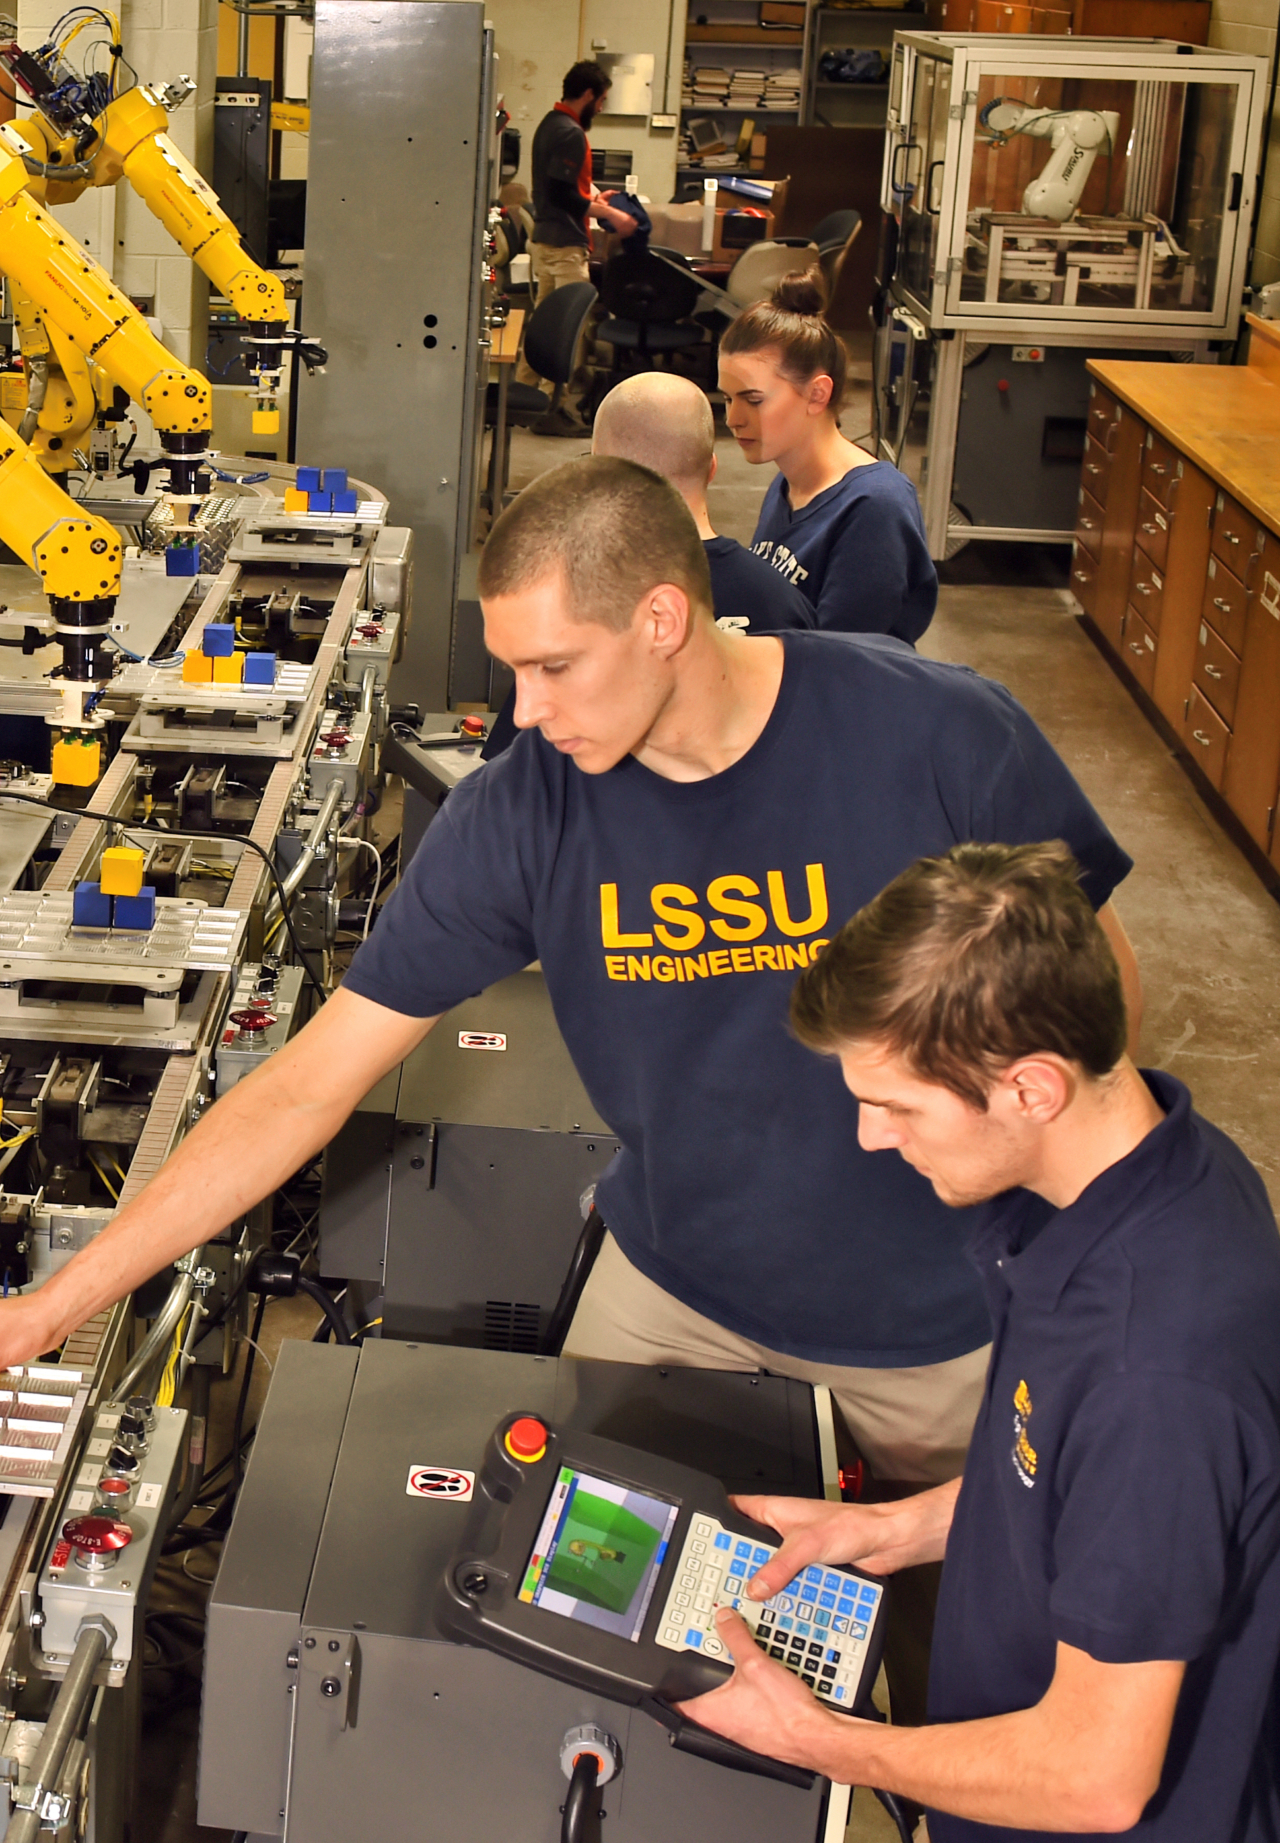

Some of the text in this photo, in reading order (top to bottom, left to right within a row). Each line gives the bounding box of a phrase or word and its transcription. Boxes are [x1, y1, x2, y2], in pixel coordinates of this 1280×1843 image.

[44, 269, 65, 291] FANUC
[599, 862, 829, 951] LSSU
[72, 1534, 102, 1547] E-STOP
[717, 1533, 727, 1548] SHIFT
[694, 1542, 703, 1551] F5
[689, 1559, 697, 1568] F4
[684, 1577, 692, 1586] F3
[679, 1594, 687, 1604] F2
[673, 1612, 681, 1621] F1
[688, 1630, 698, 1645] SHIFT
[793, 1639, 803, 1647] 6
[789, 1654, 798, 1662] 5
